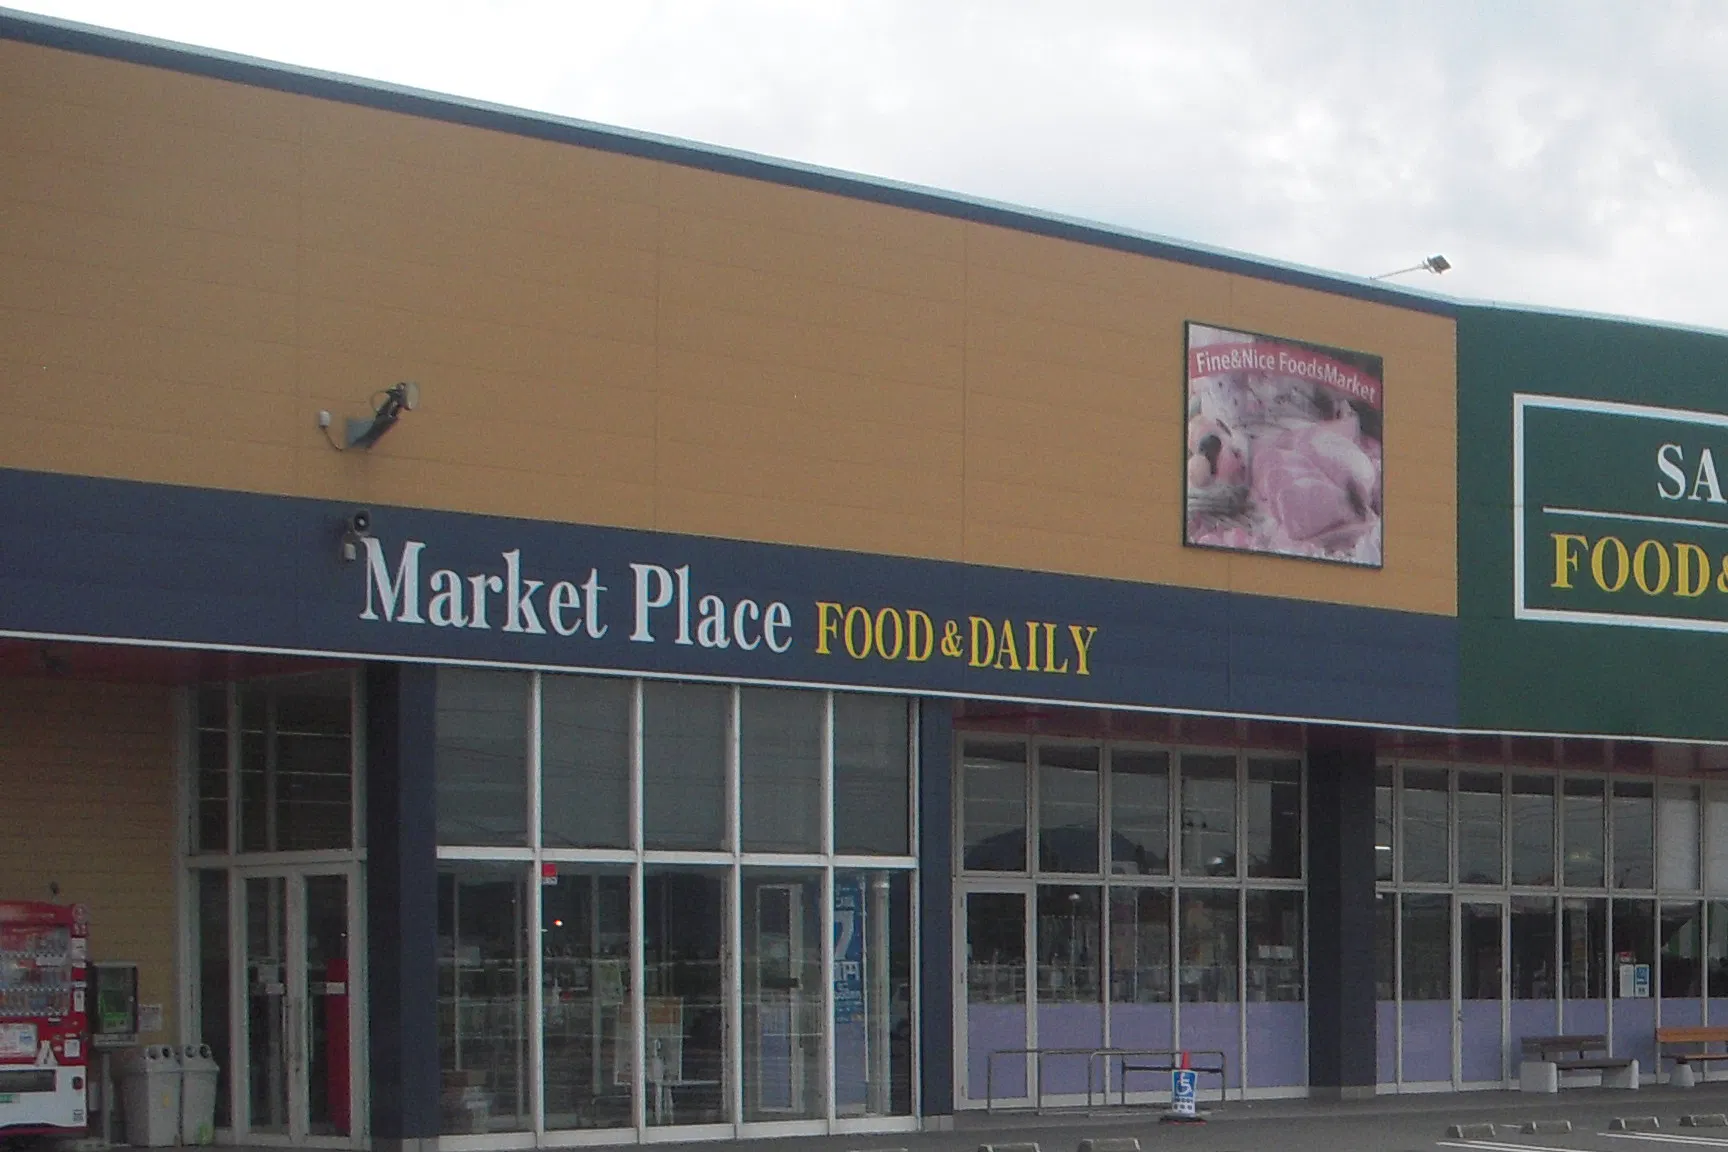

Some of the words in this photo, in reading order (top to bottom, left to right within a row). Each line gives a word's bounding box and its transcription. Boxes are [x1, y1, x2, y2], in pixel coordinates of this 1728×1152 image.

[1195, 348, 1276, 373] Fine&Nice
[358, 535, 609, 640] Market
[628, 561, 793, 654] Place
